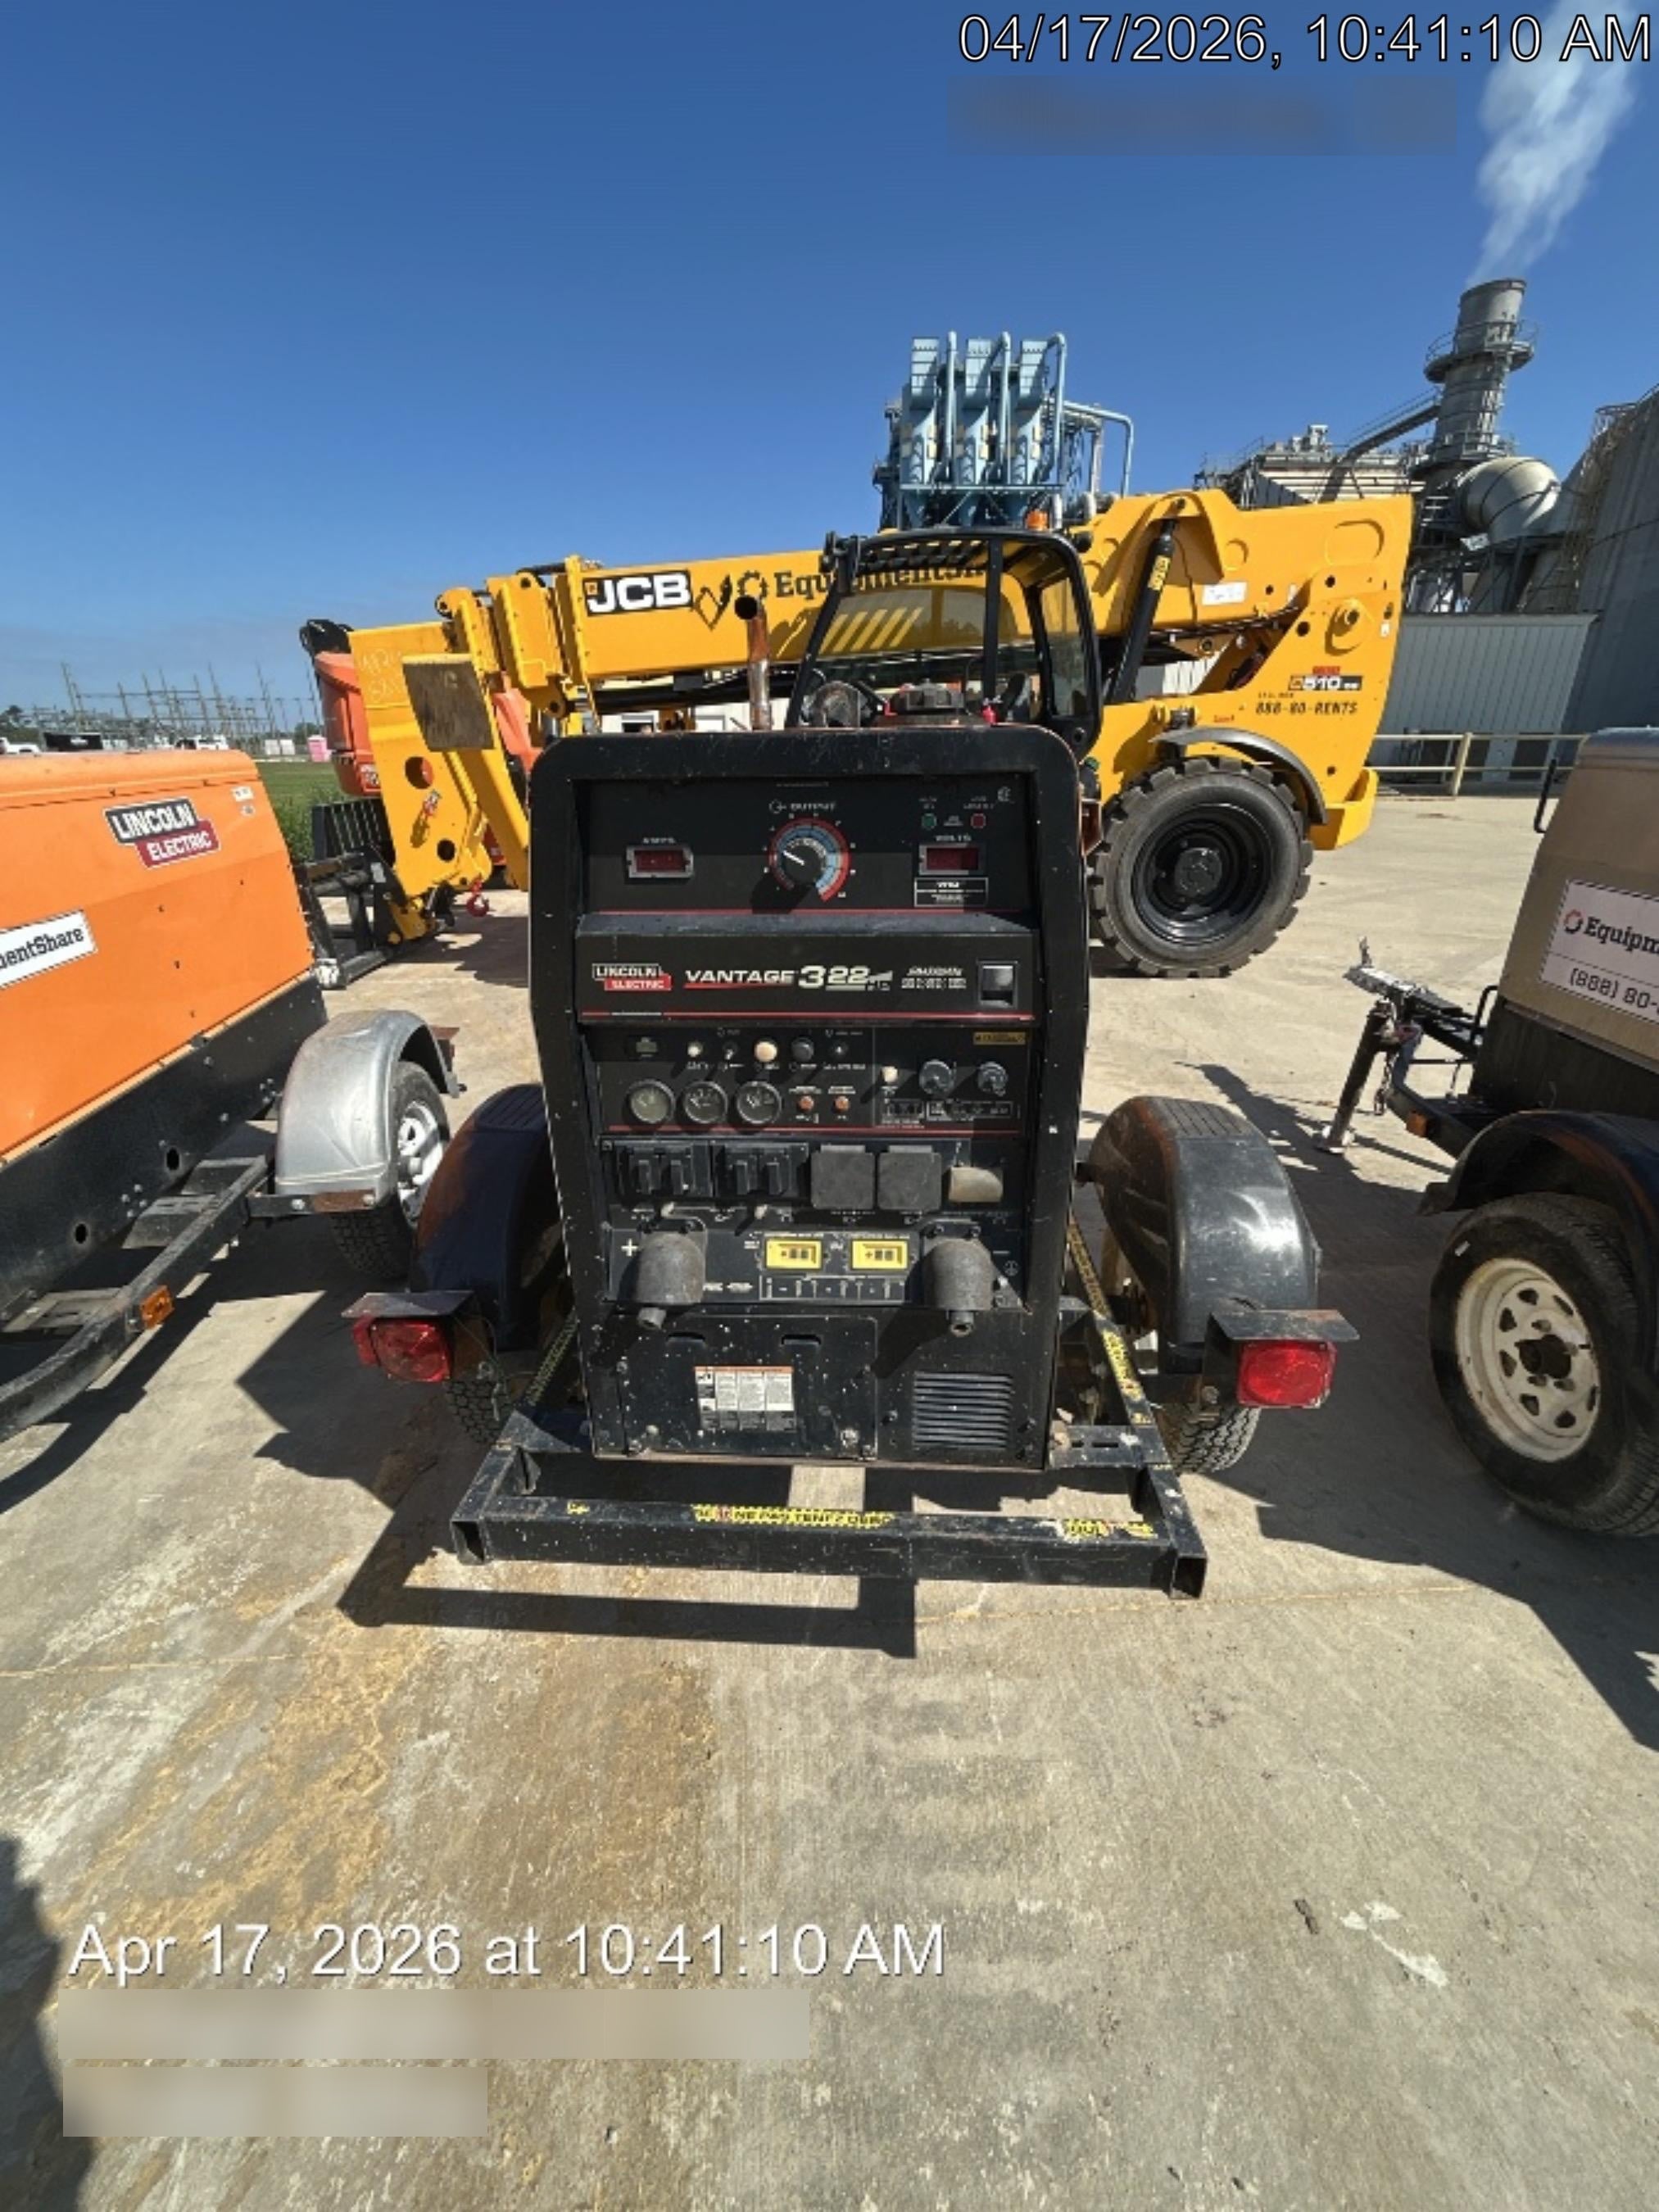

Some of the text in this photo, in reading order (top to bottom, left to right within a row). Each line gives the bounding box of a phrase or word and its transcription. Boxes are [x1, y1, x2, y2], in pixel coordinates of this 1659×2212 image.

[587, 574, 691, 613] JCB
[111, 803, 195, 840] LINCOLN
[147, 831, 212, 861] ELECTRIC
[596, 966, 656, 977] LINCOLN
[611, 980, 664, 990] ELECTRIC
[685, 970, 796, 984] VANTAGE
[1570, 968, 1659, 1016] (888) 80-
